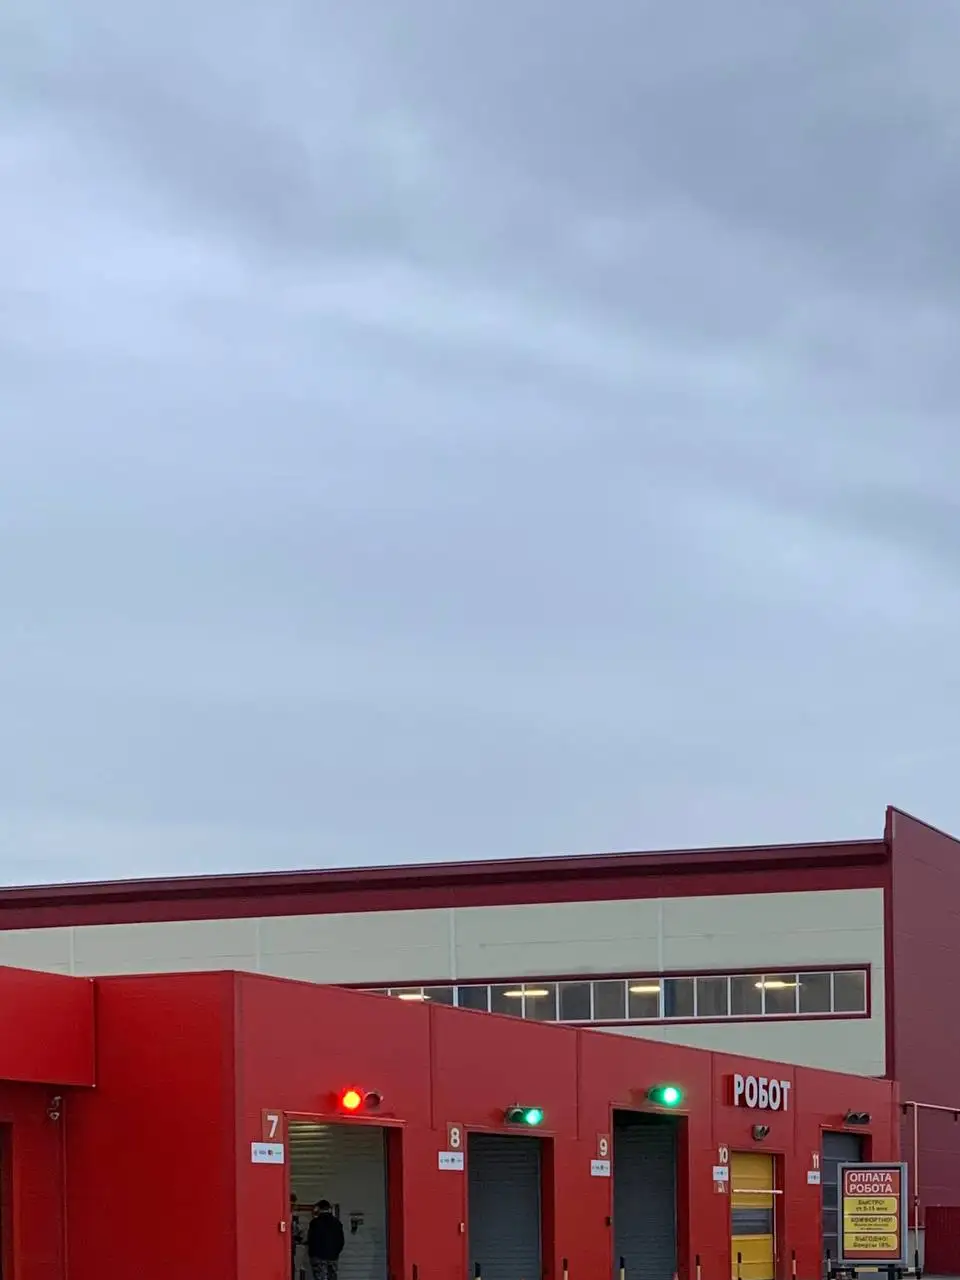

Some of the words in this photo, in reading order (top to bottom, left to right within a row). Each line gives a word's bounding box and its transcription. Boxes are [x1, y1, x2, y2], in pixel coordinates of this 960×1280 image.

[734, 1074, 791, 1111] РОБОТ
[267, 1115, 279, 1138] 7
[450, 1127, 460, 1148] 8
[599, 1138, 608, 1157] 9
[718, 1147, 729, 1164] 10
[812, 1153, 820, 1169] 11
[849, 1173, 893, 1182] ОПЛАТА
[849, 1183, 893, 1193] РОБОТА
